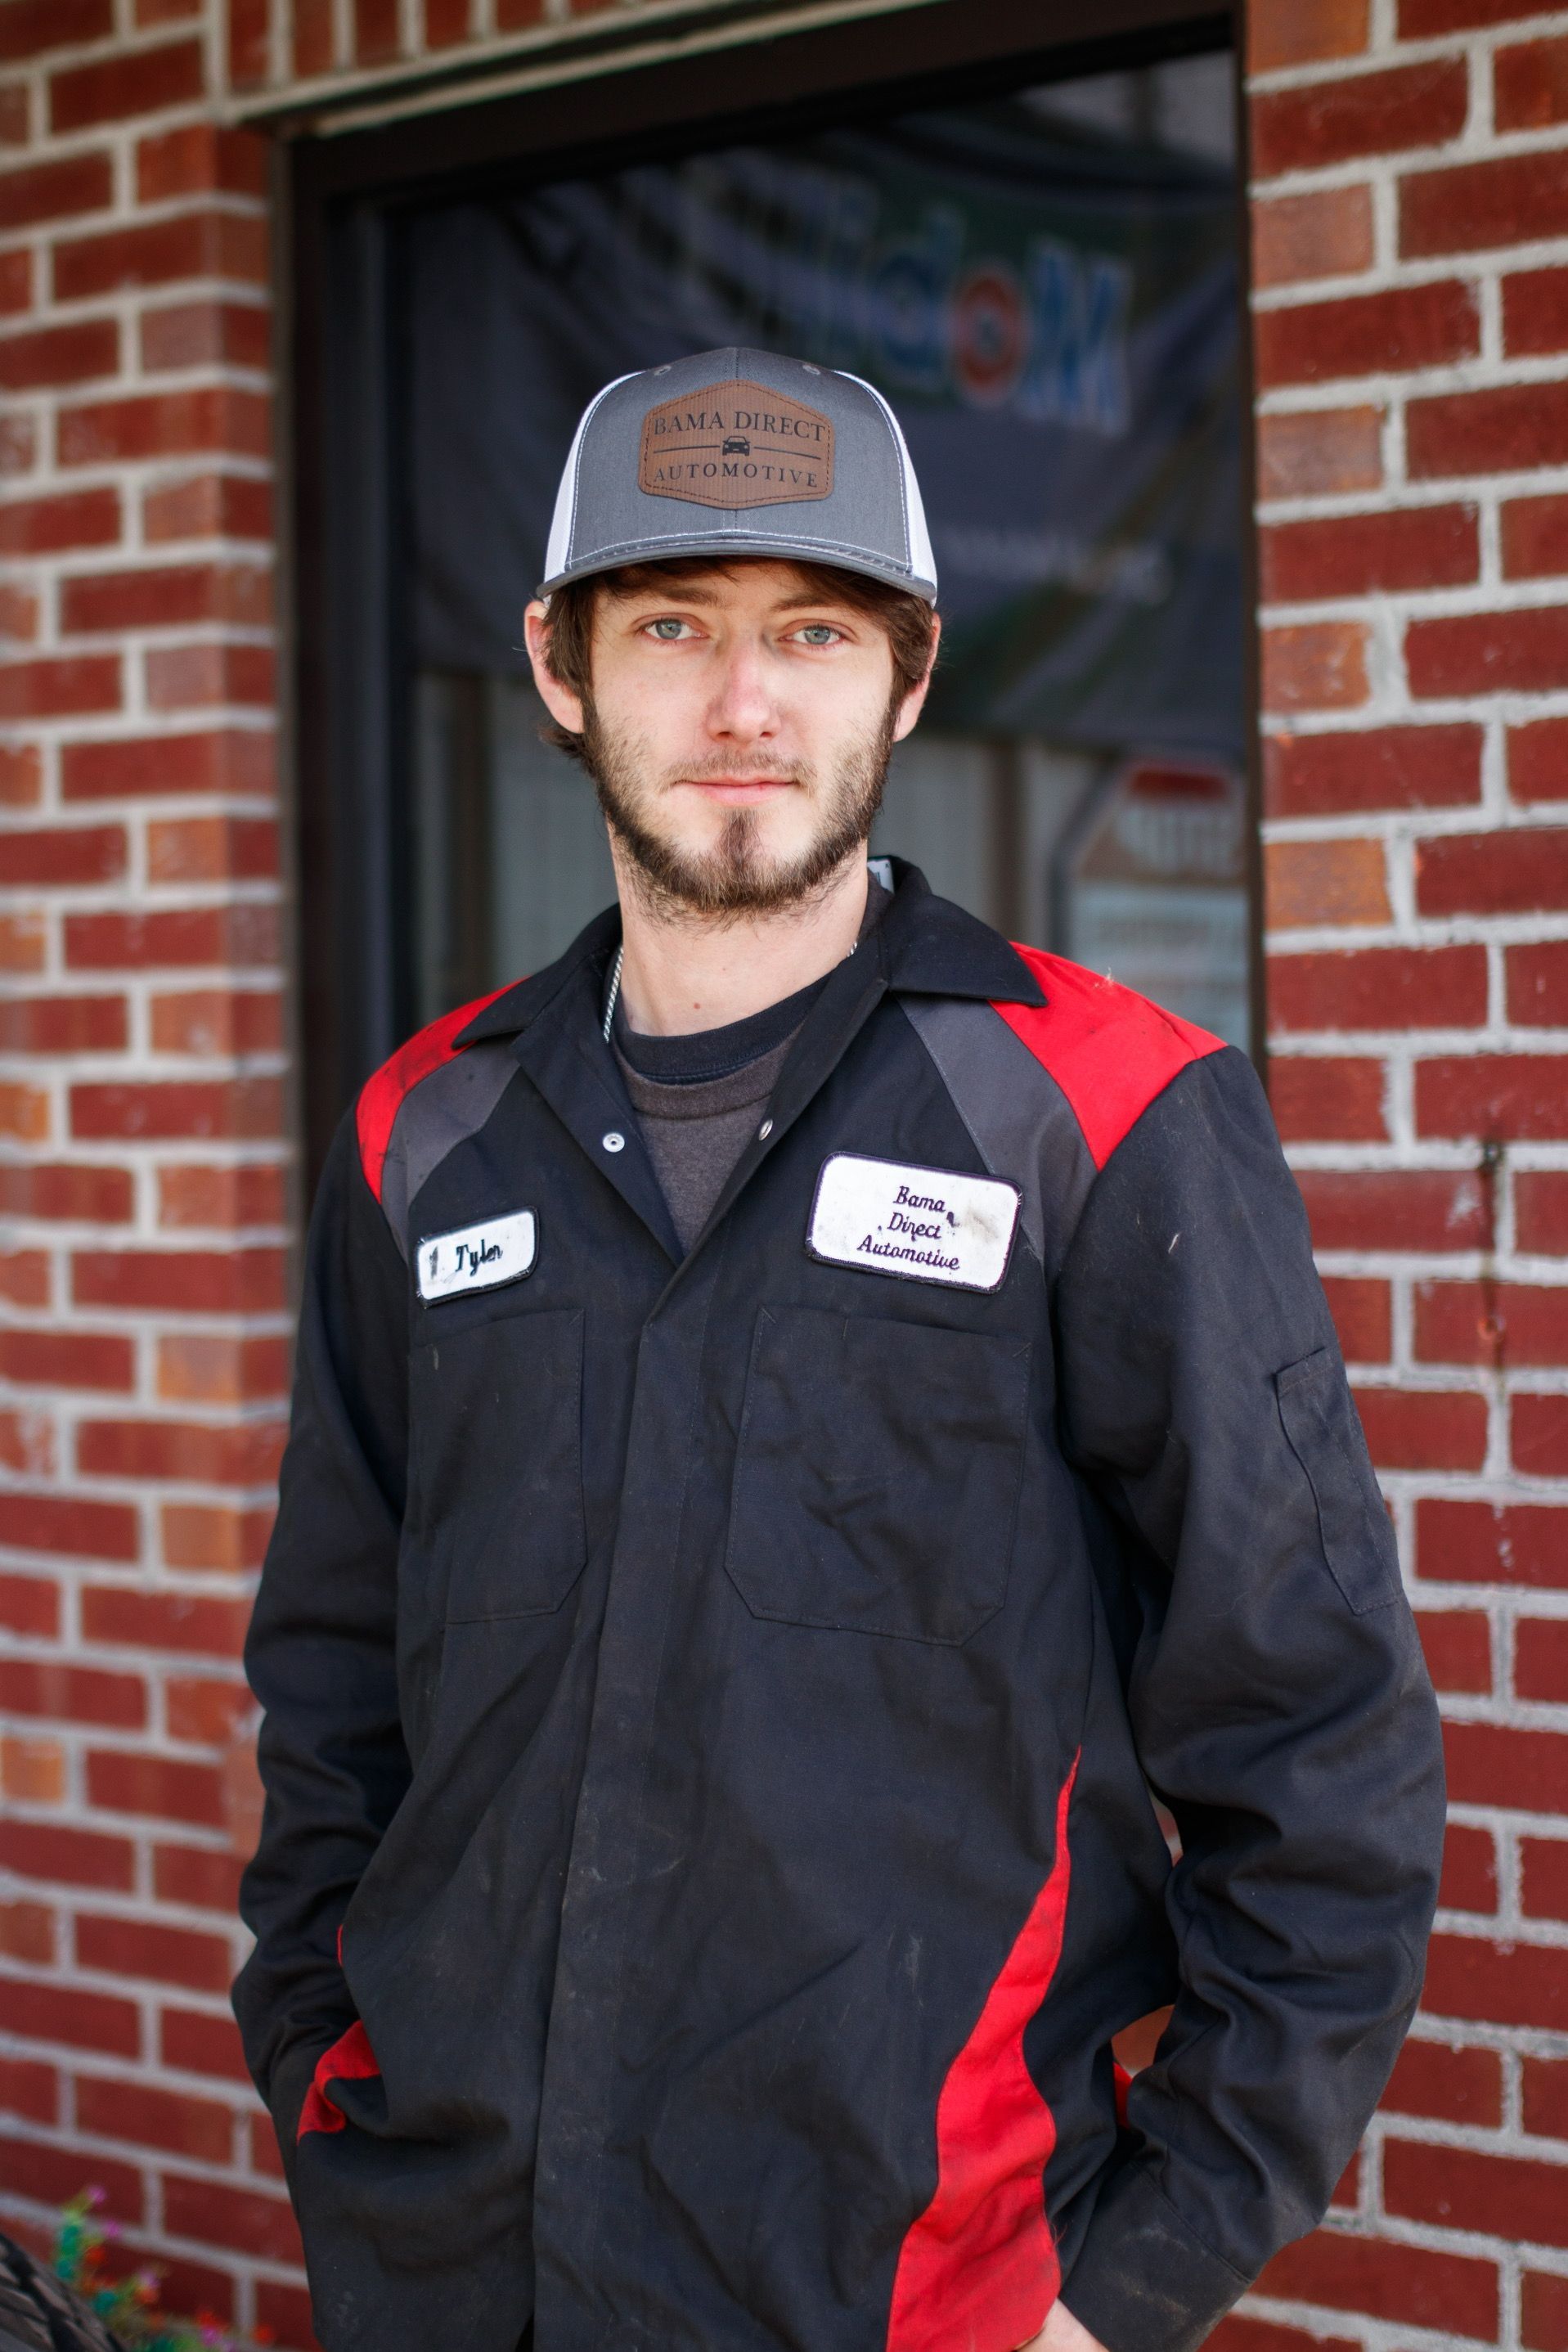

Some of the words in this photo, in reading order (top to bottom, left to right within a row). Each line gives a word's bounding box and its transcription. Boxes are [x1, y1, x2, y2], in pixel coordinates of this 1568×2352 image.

[654, 411, 724, 435] BAMA
[733, 411, 825, 441] DIRECT
[654, 463, 817, 488] AUTOMOTIVE
[892, 1185, 946, 1212] Bama
[887, 1212, 942, 1239] Direct
[857, 1234, 960, 1270] Automotive
